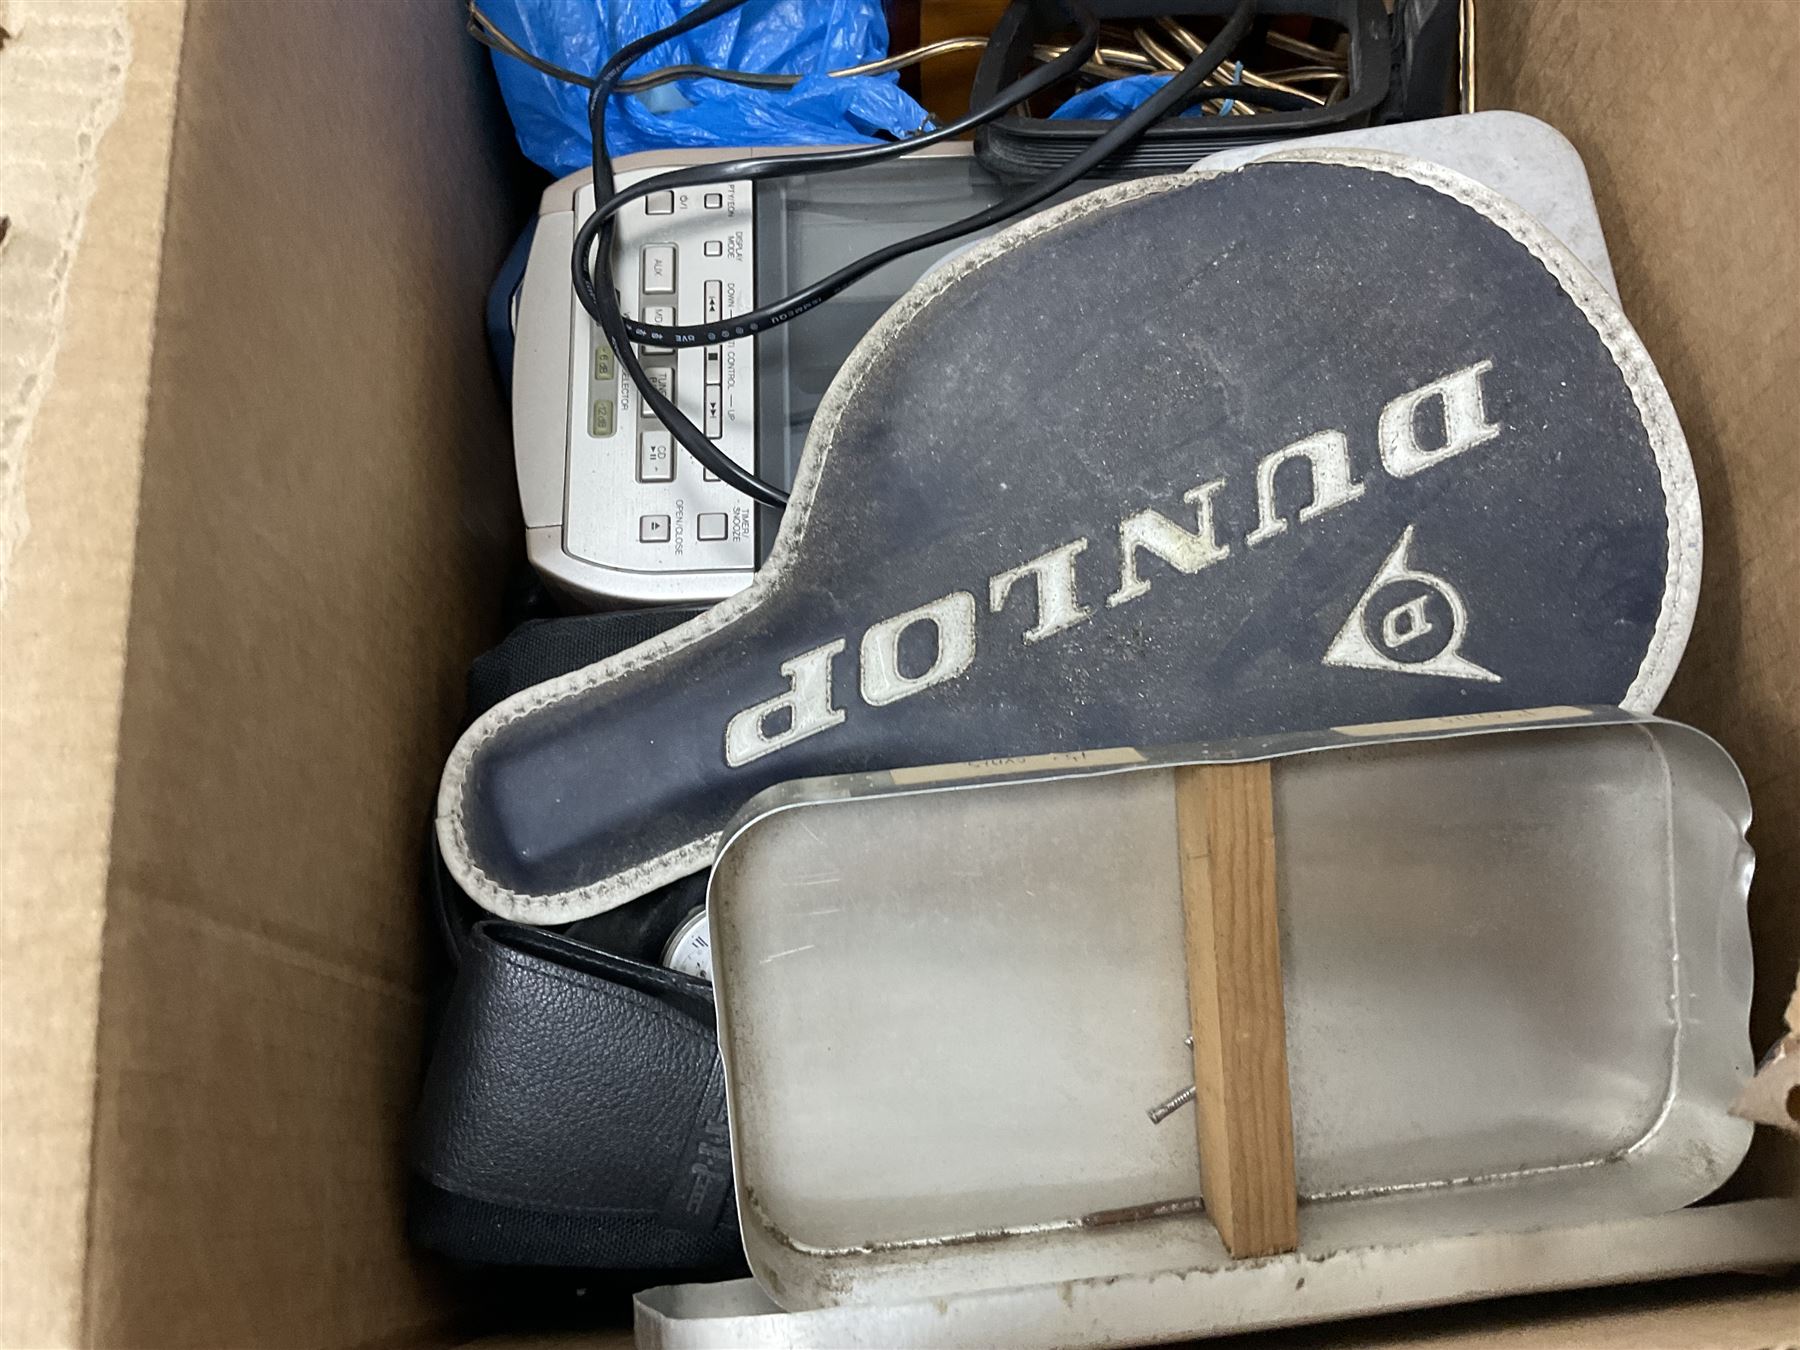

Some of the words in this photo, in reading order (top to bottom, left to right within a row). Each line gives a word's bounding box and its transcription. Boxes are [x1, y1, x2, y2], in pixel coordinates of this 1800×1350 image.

[727, 236, 735, 259] MODE
[653, 258, 663, 277] AUX
[727, 282, 735, 308] DOWN
[727, 351, 736, 390] CONTROL
[727, 409, 736, 422] UP
[657, 445, 667, 460] CD
[674, 499, 685, 557] OPEN/CLOSE
[732, 505, 742, 543] SNOOZE
[741, 508, 751, 539] TIMER/
[725, 359, 1502, 769] DUNLOP
[1382, 594, 1434, 649] D
